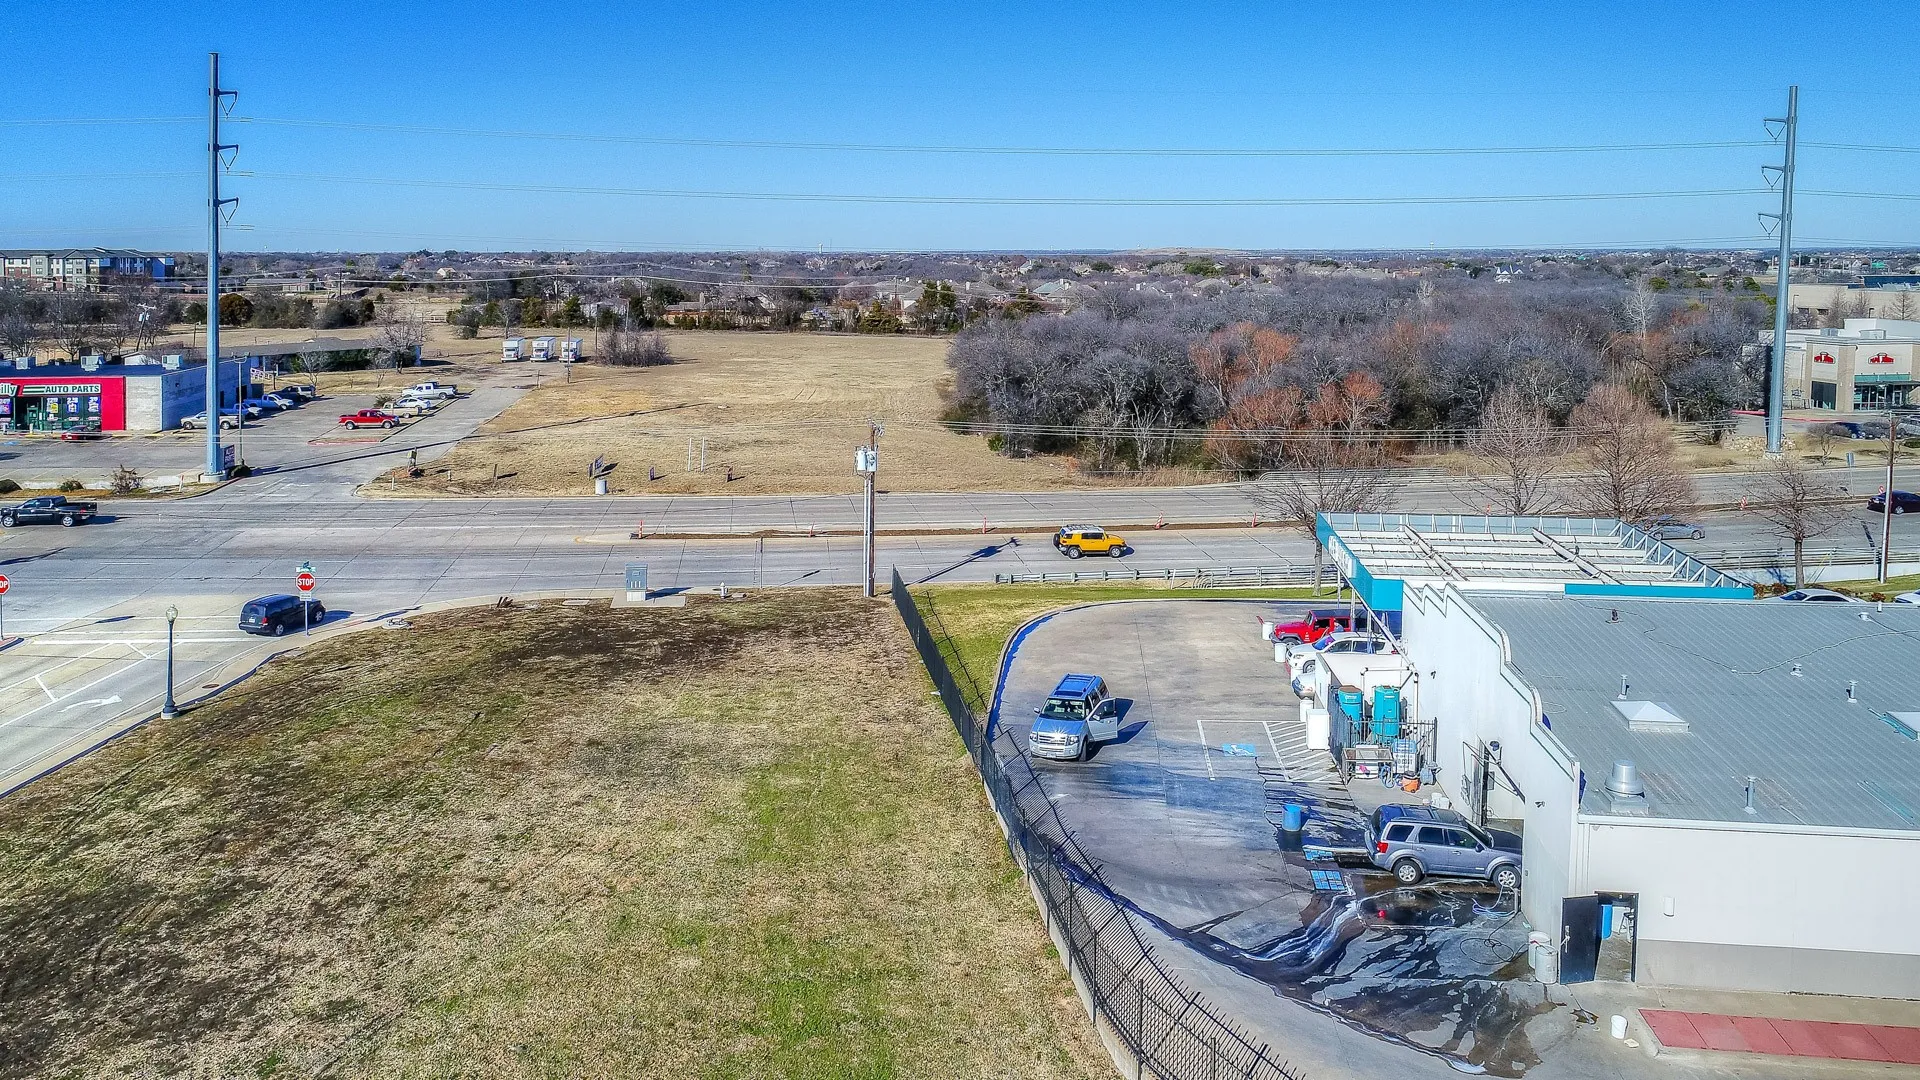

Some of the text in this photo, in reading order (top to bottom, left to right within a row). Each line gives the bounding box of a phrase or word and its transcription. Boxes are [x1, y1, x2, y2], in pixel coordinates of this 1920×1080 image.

[45, 385, 69, 393] AUTO
[71, 385, 100, 393] PARTS
[298, 578, 314, 586] STOP
